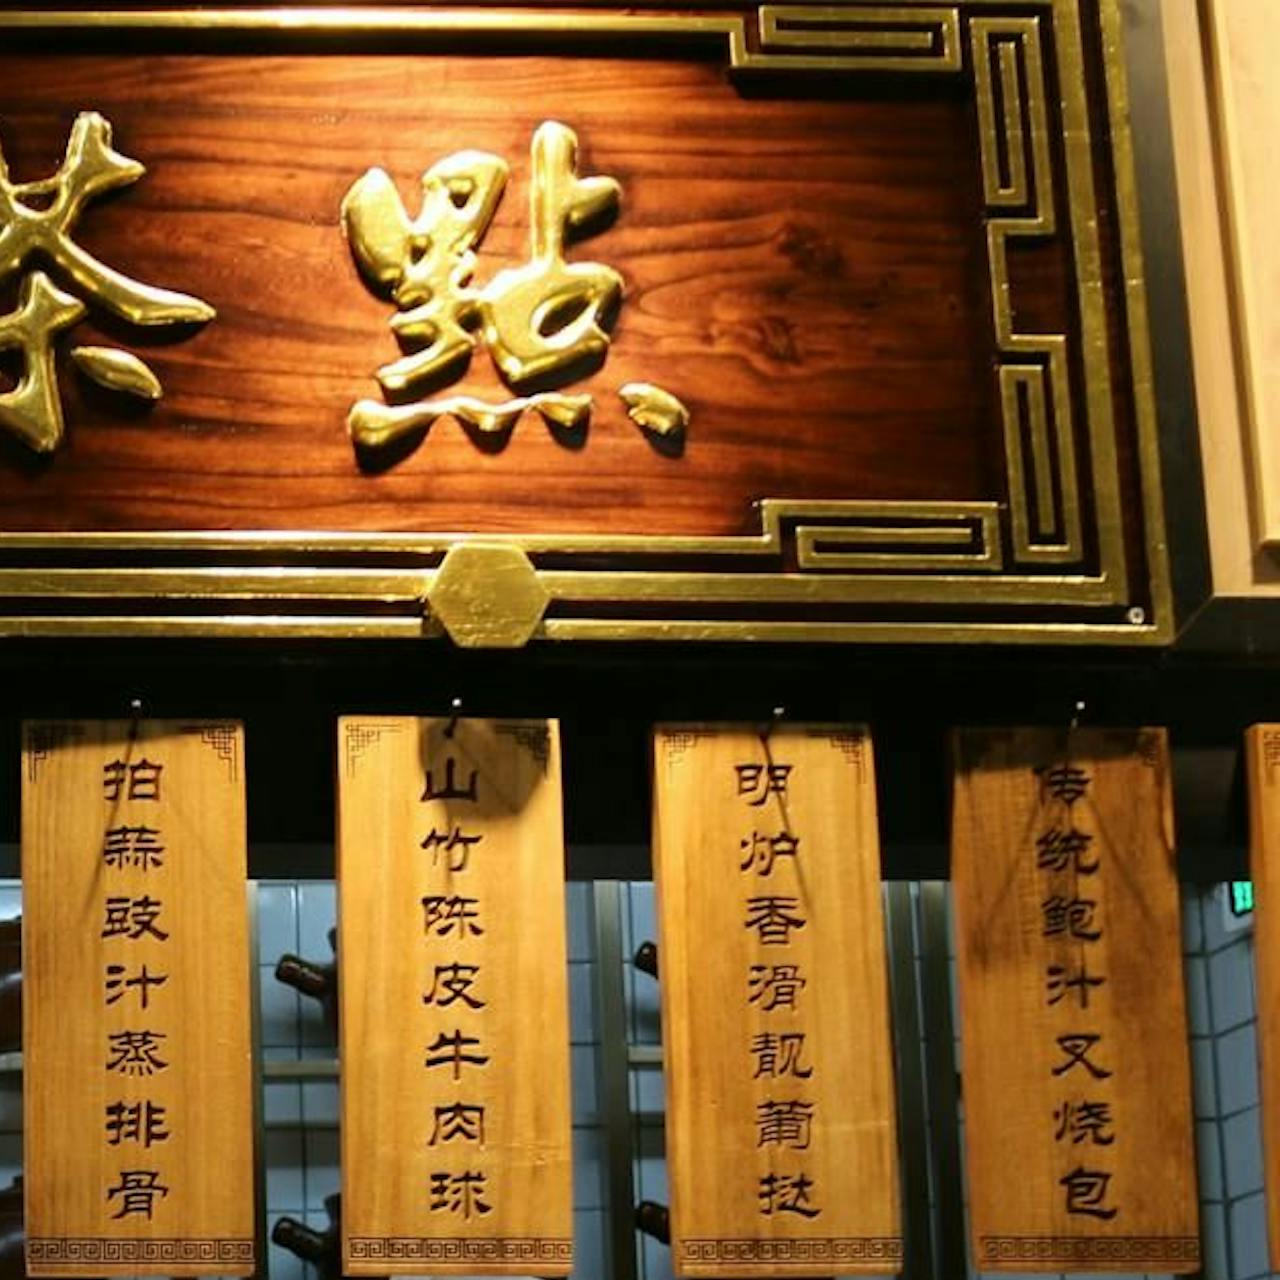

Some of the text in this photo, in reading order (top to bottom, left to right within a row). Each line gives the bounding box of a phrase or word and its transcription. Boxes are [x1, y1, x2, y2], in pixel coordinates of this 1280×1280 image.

[101, 758, 171, 1221] 拍蒜豉汁蒸排骨
[419, 758, 492, 1222] 山竹陈皮牛肉球
[734, 762, 822, 1220] 明炉香滑靓葡挞
[1033, 765, 1118, 1222] 传统鲍汁叉烧包
